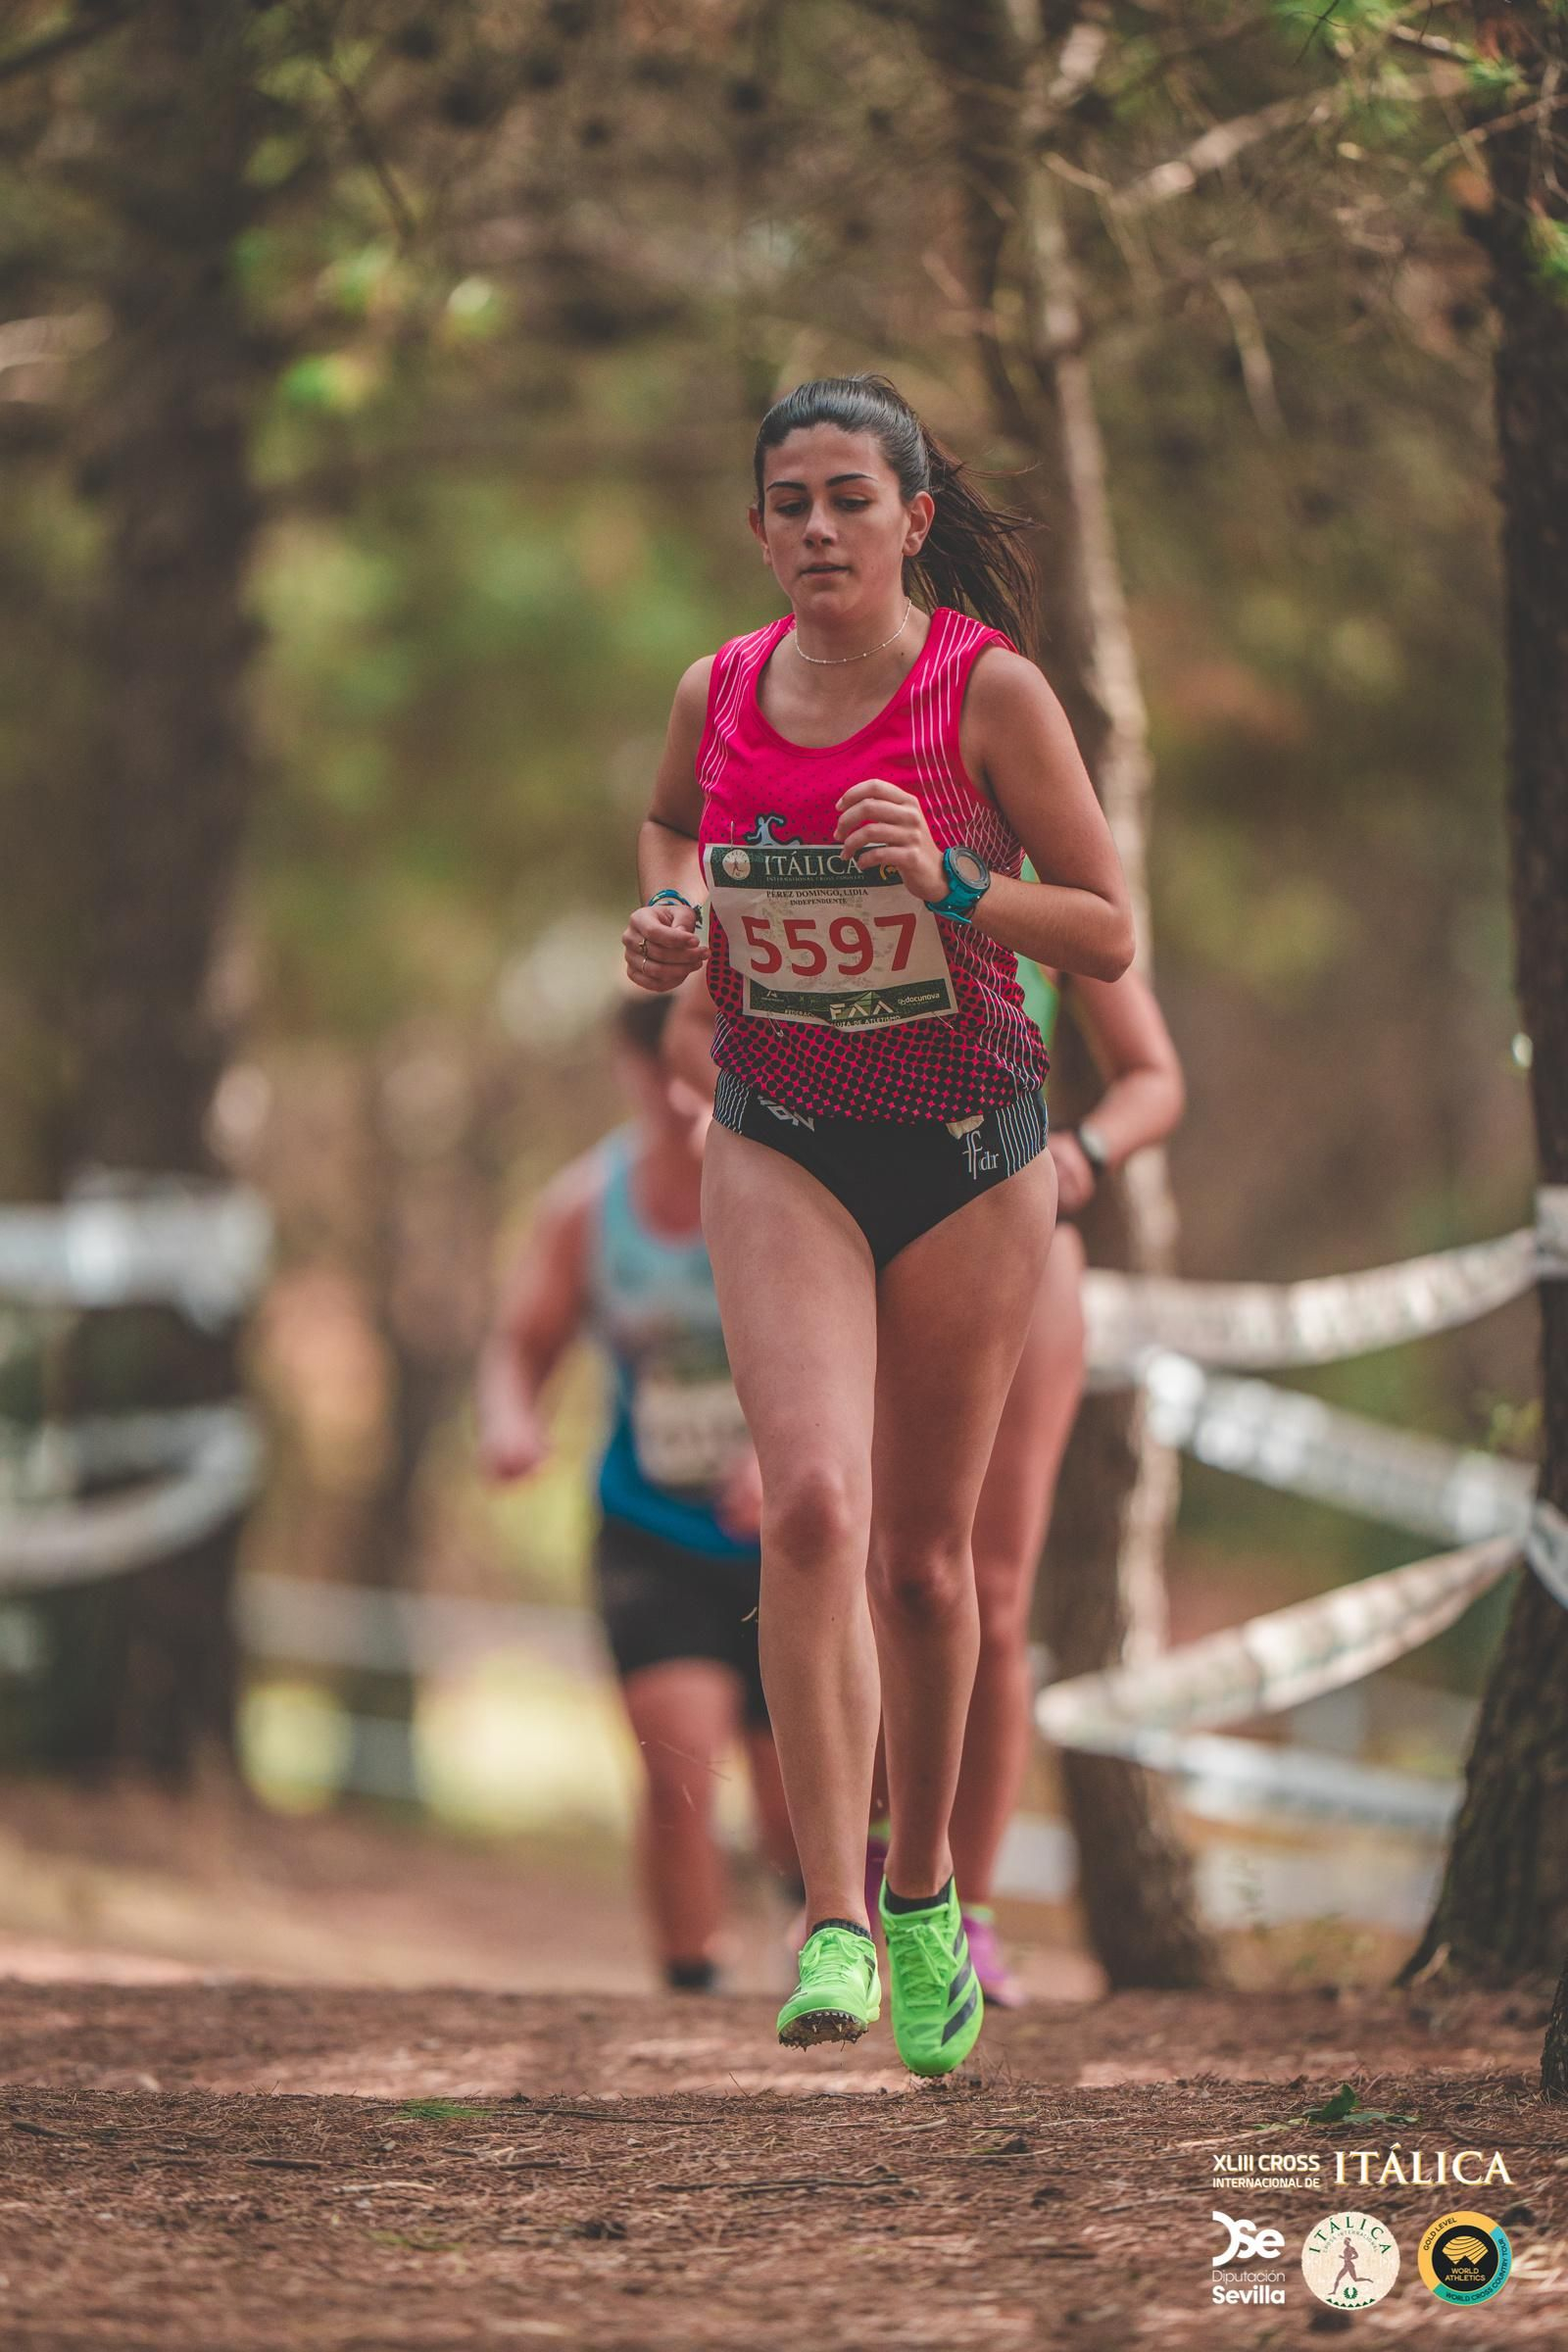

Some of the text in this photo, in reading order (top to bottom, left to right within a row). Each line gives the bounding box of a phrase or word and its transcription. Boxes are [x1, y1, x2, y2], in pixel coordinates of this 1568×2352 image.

[764, 851, 863, 876] ITÁLICA
[796, 889, 843, 899] DOMINGO,
[844, 888, 869, 897] LIDIA
[741, 913, 917, 976] 5597
[905, 992, 941, 1004] docunova
[864, 1014, 902, 1026] ATLETISMO
